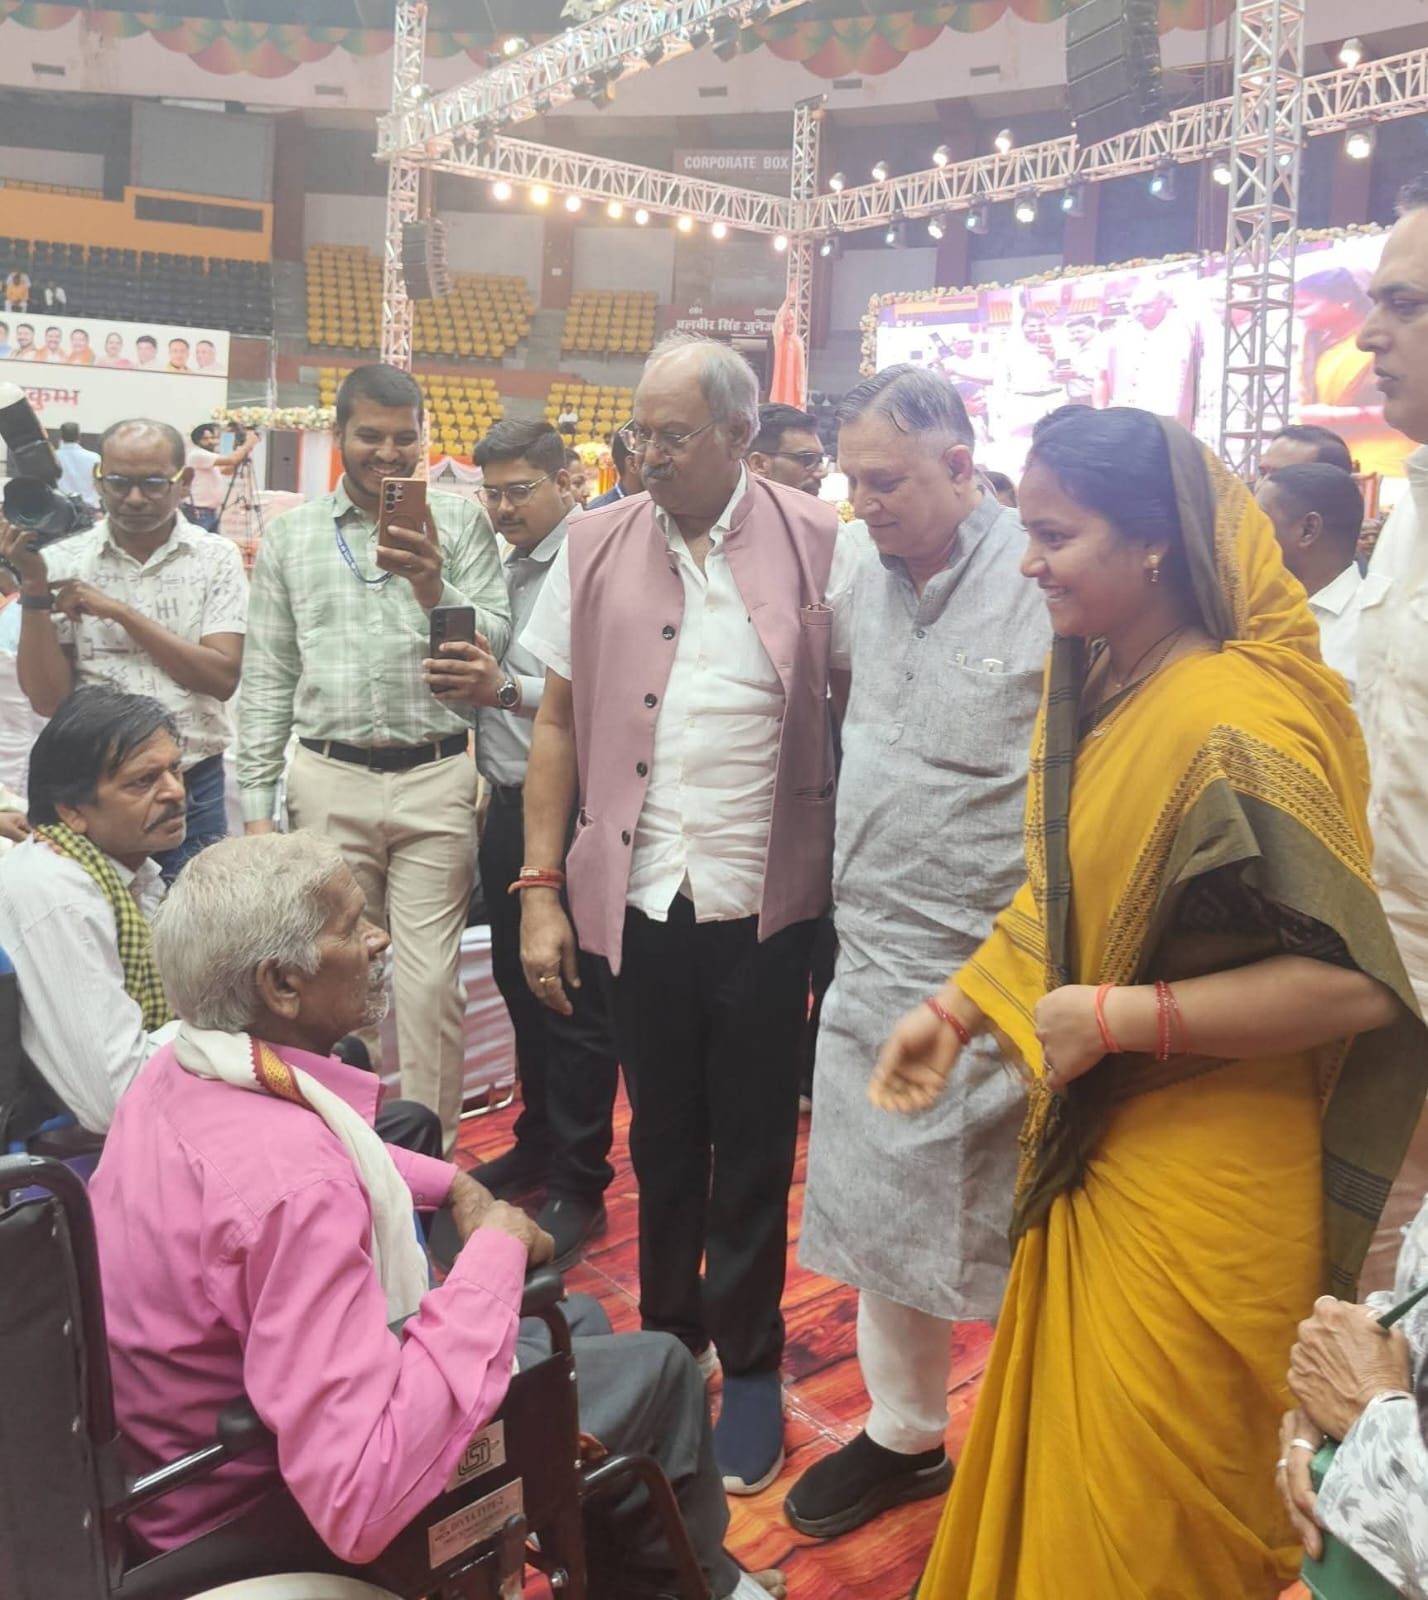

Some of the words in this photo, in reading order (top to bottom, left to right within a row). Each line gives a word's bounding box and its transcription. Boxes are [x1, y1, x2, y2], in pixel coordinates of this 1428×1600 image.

[684, 156, 757, 169] CORPORATE
[763, 156, 789, 169] BOX
[20, 386, 80, 411] कुम्भ
